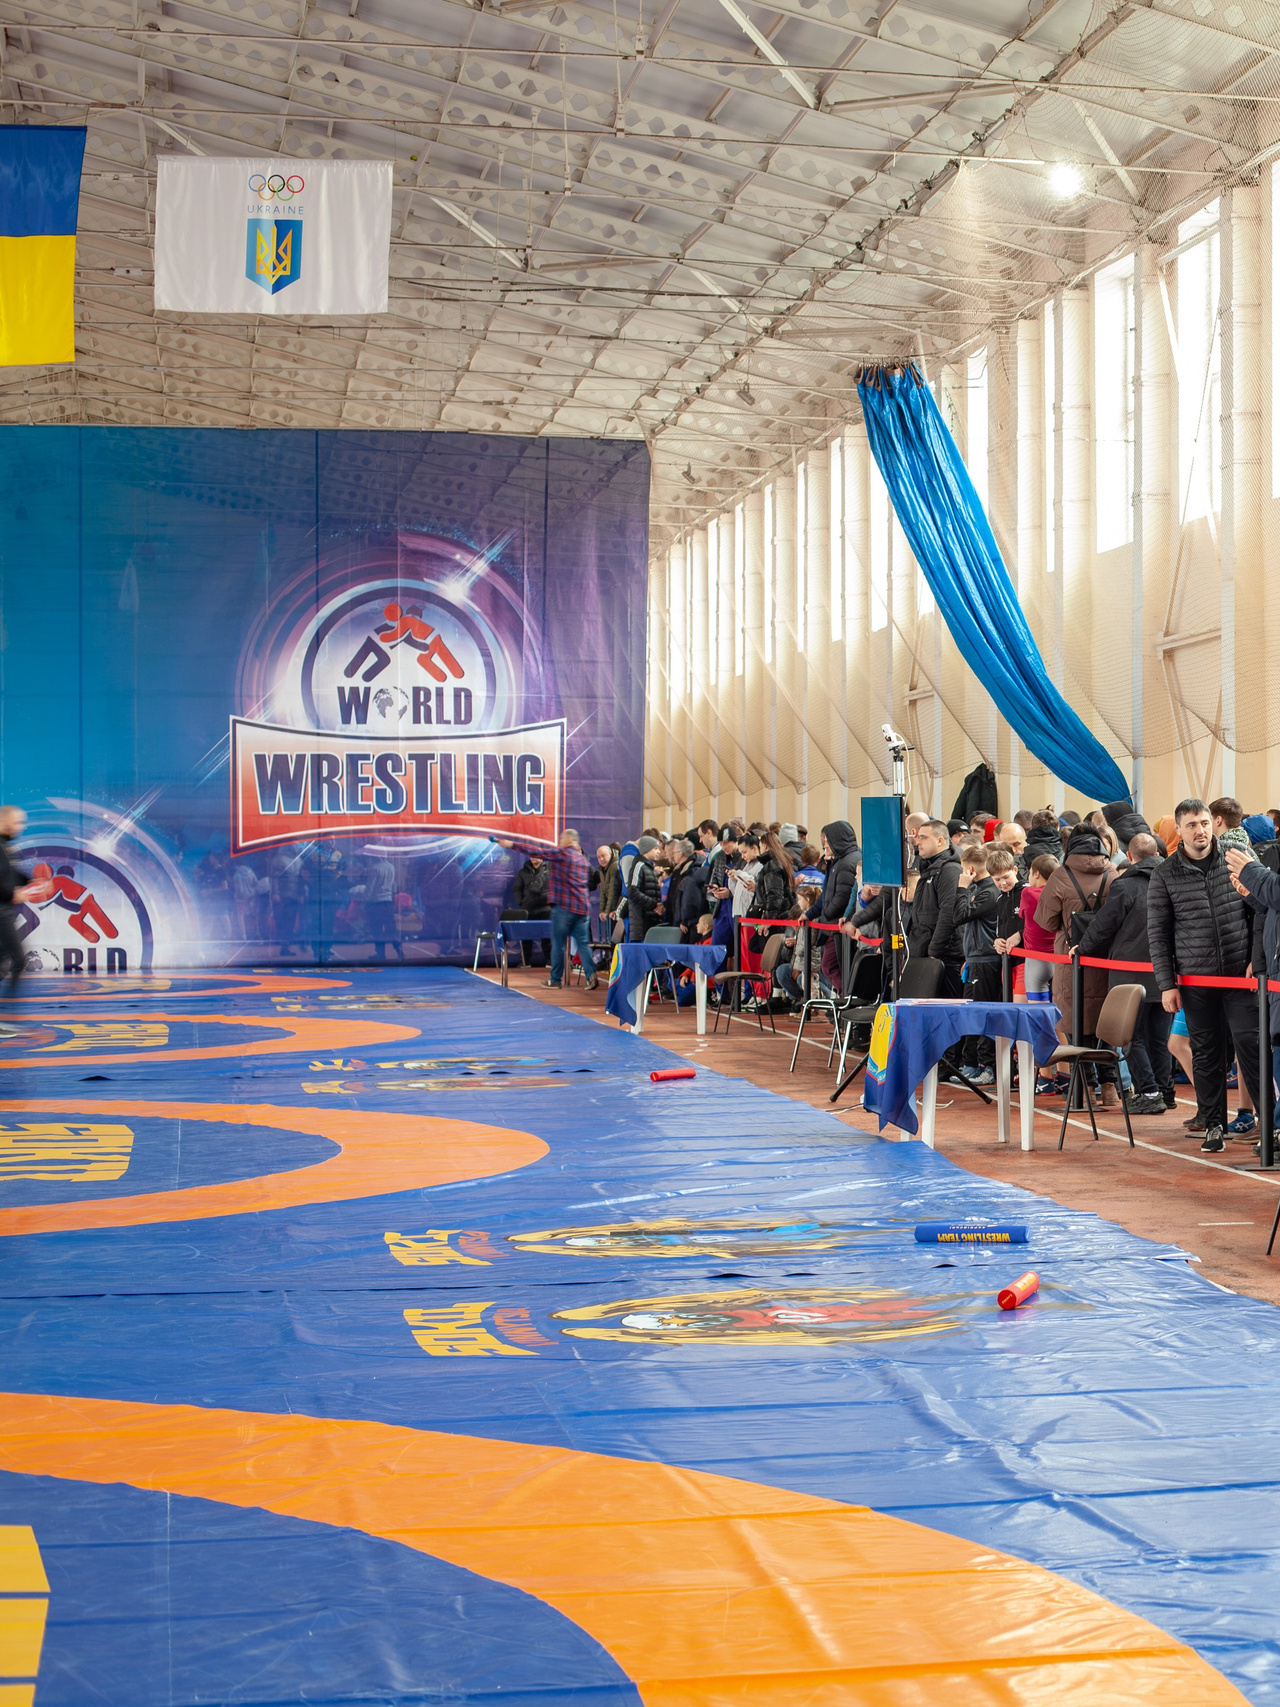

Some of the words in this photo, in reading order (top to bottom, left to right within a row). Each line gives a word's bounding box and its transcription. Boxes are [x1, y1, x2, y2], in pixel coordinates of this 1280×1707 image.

[247, 205, 304, 215] UKRAINE
[252, 752, 545, 815] WRESTLING
[937, 1232, 960, 1243] TEAM
[960, 1232, 1011, 1242] WRESTLING
[403, 1301, 541, 1356] SOKIL
